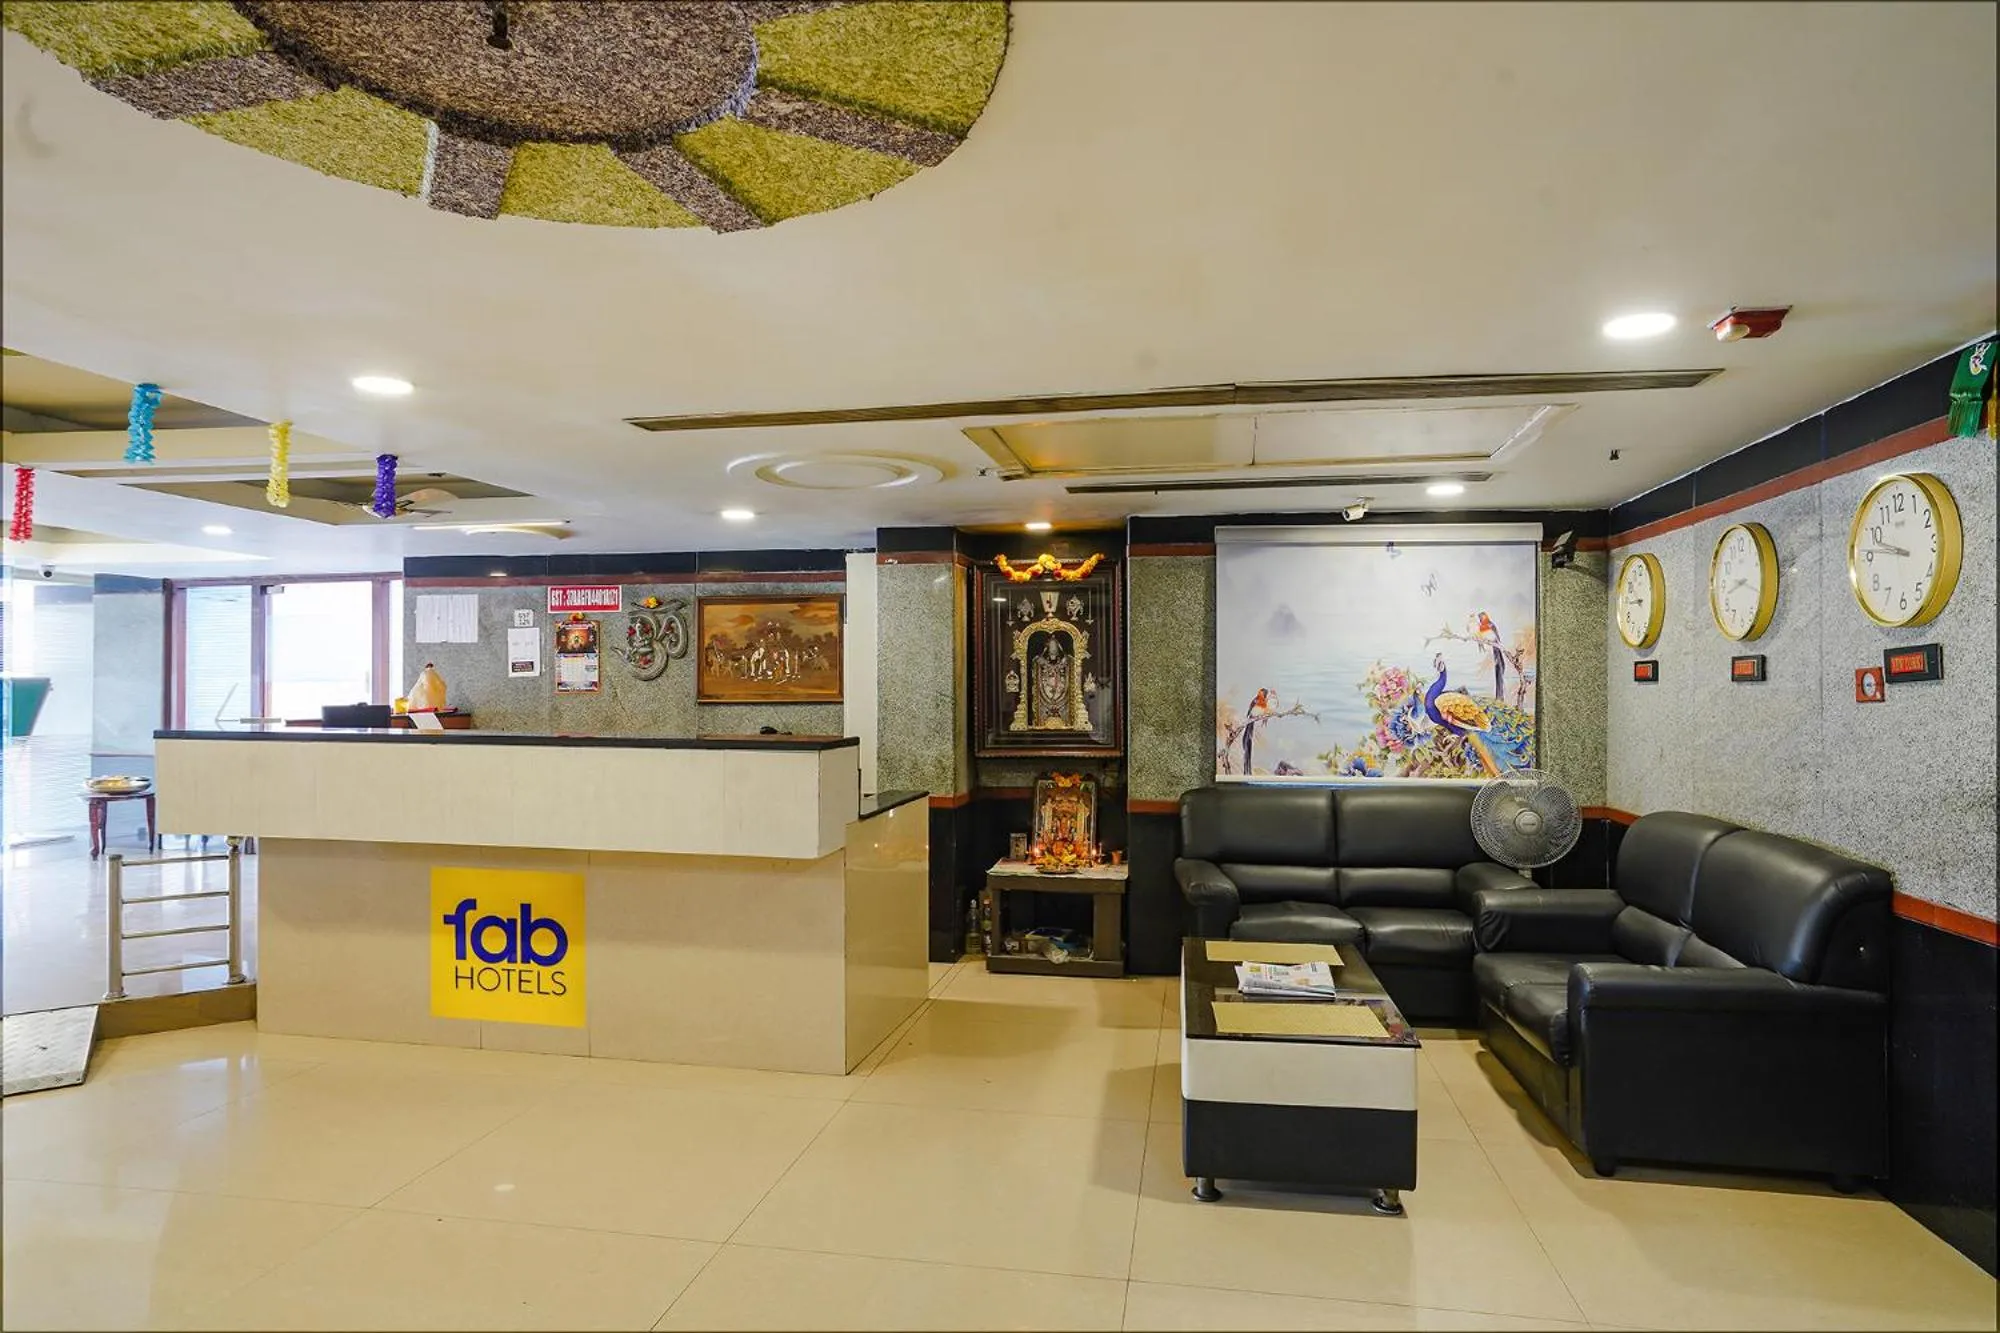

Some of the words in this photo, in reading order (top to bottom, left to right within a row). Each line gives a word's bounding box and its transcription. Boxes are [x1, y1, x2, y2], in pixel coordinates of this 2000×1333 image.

[1892, 493, 1905, 513] 12
[1912, 494, 1917, 514] 1
[1880, 505, 1891, 526] 11
[1923, 508, 1932, 529] 2
[1870, 526, 1882, 546] 10
[1930, 533, 1937, 553] 3
[1873, 573, 1880, 592] 8
[1915, 582, 1923, 602] 5
[1884, 587, 1892, 608] 7
[1900, 591, 1908, 611] 6
[443, 898, 569, 967] fab
[454, 965, 567, 997] HOTELS
